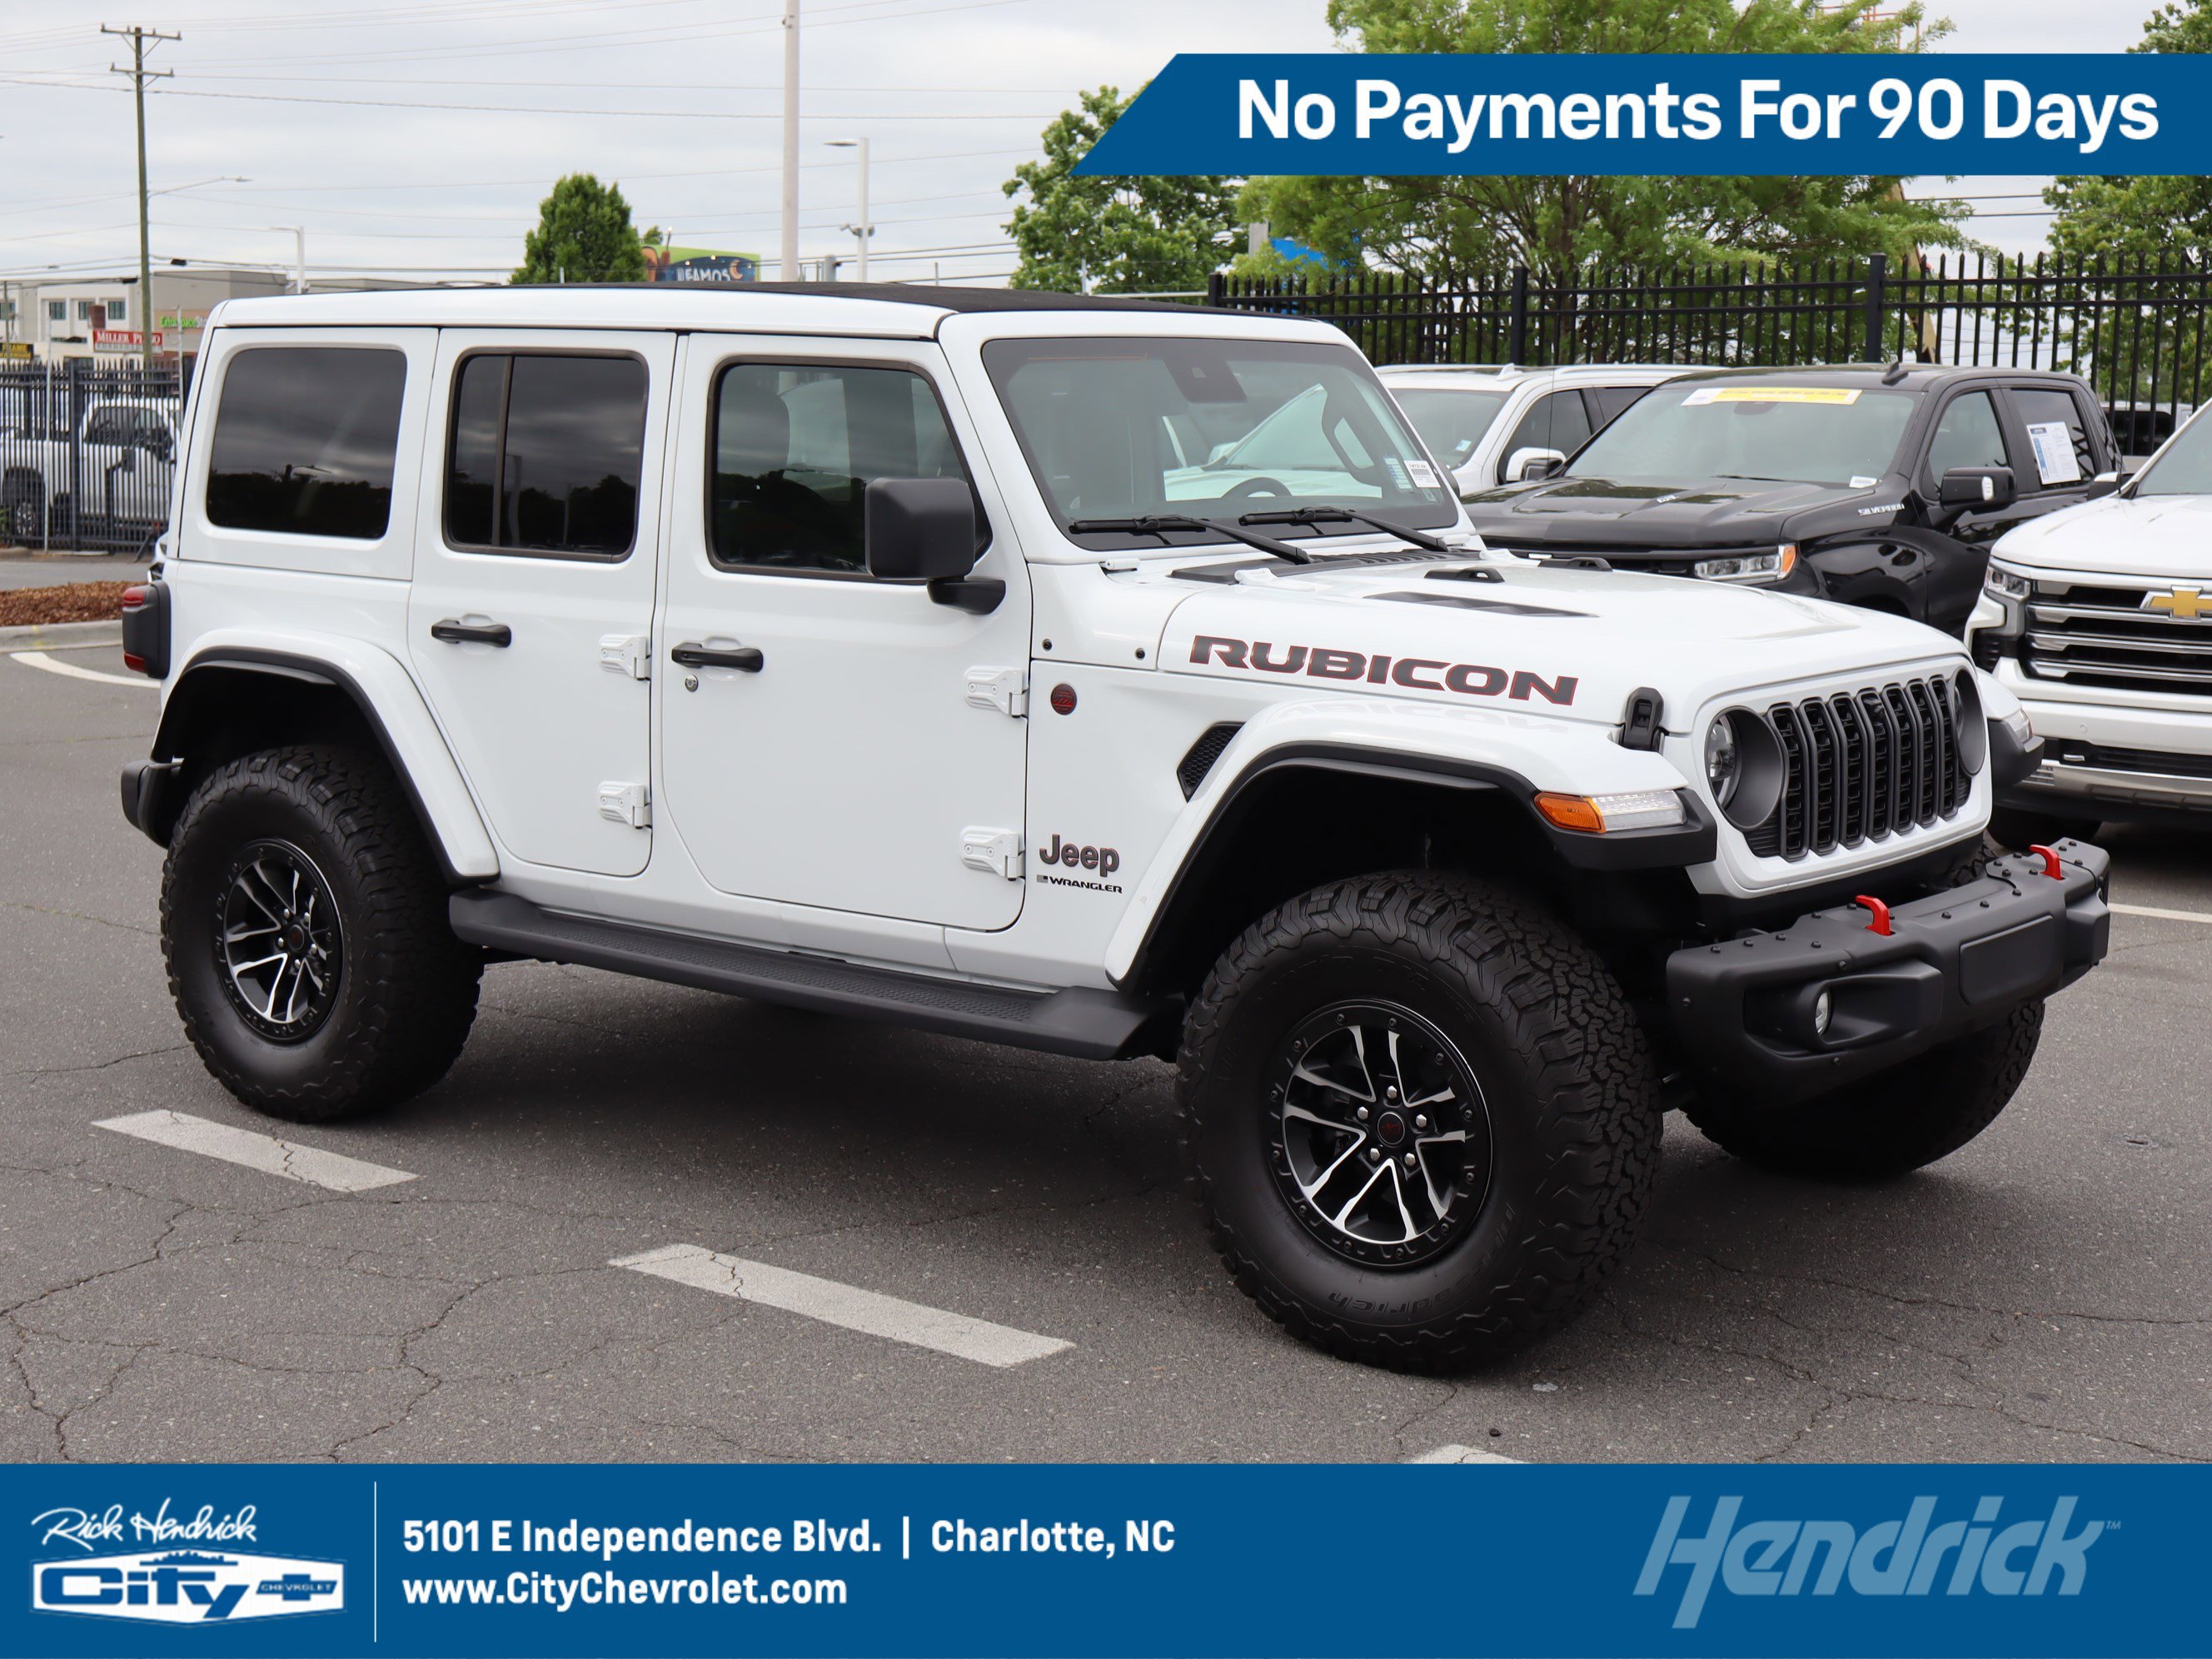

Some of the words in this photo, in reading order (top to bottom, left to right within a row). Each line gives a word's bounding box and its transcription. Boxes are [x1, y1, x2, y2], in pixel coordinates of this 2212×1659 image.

[96, 331, 129, 343] MILLER
[1189, 634, 1579, 707] RUBICON
[1039, 834, 1120, 878] Jeep
[1049, 875, 1123, 894] WRANGLER
